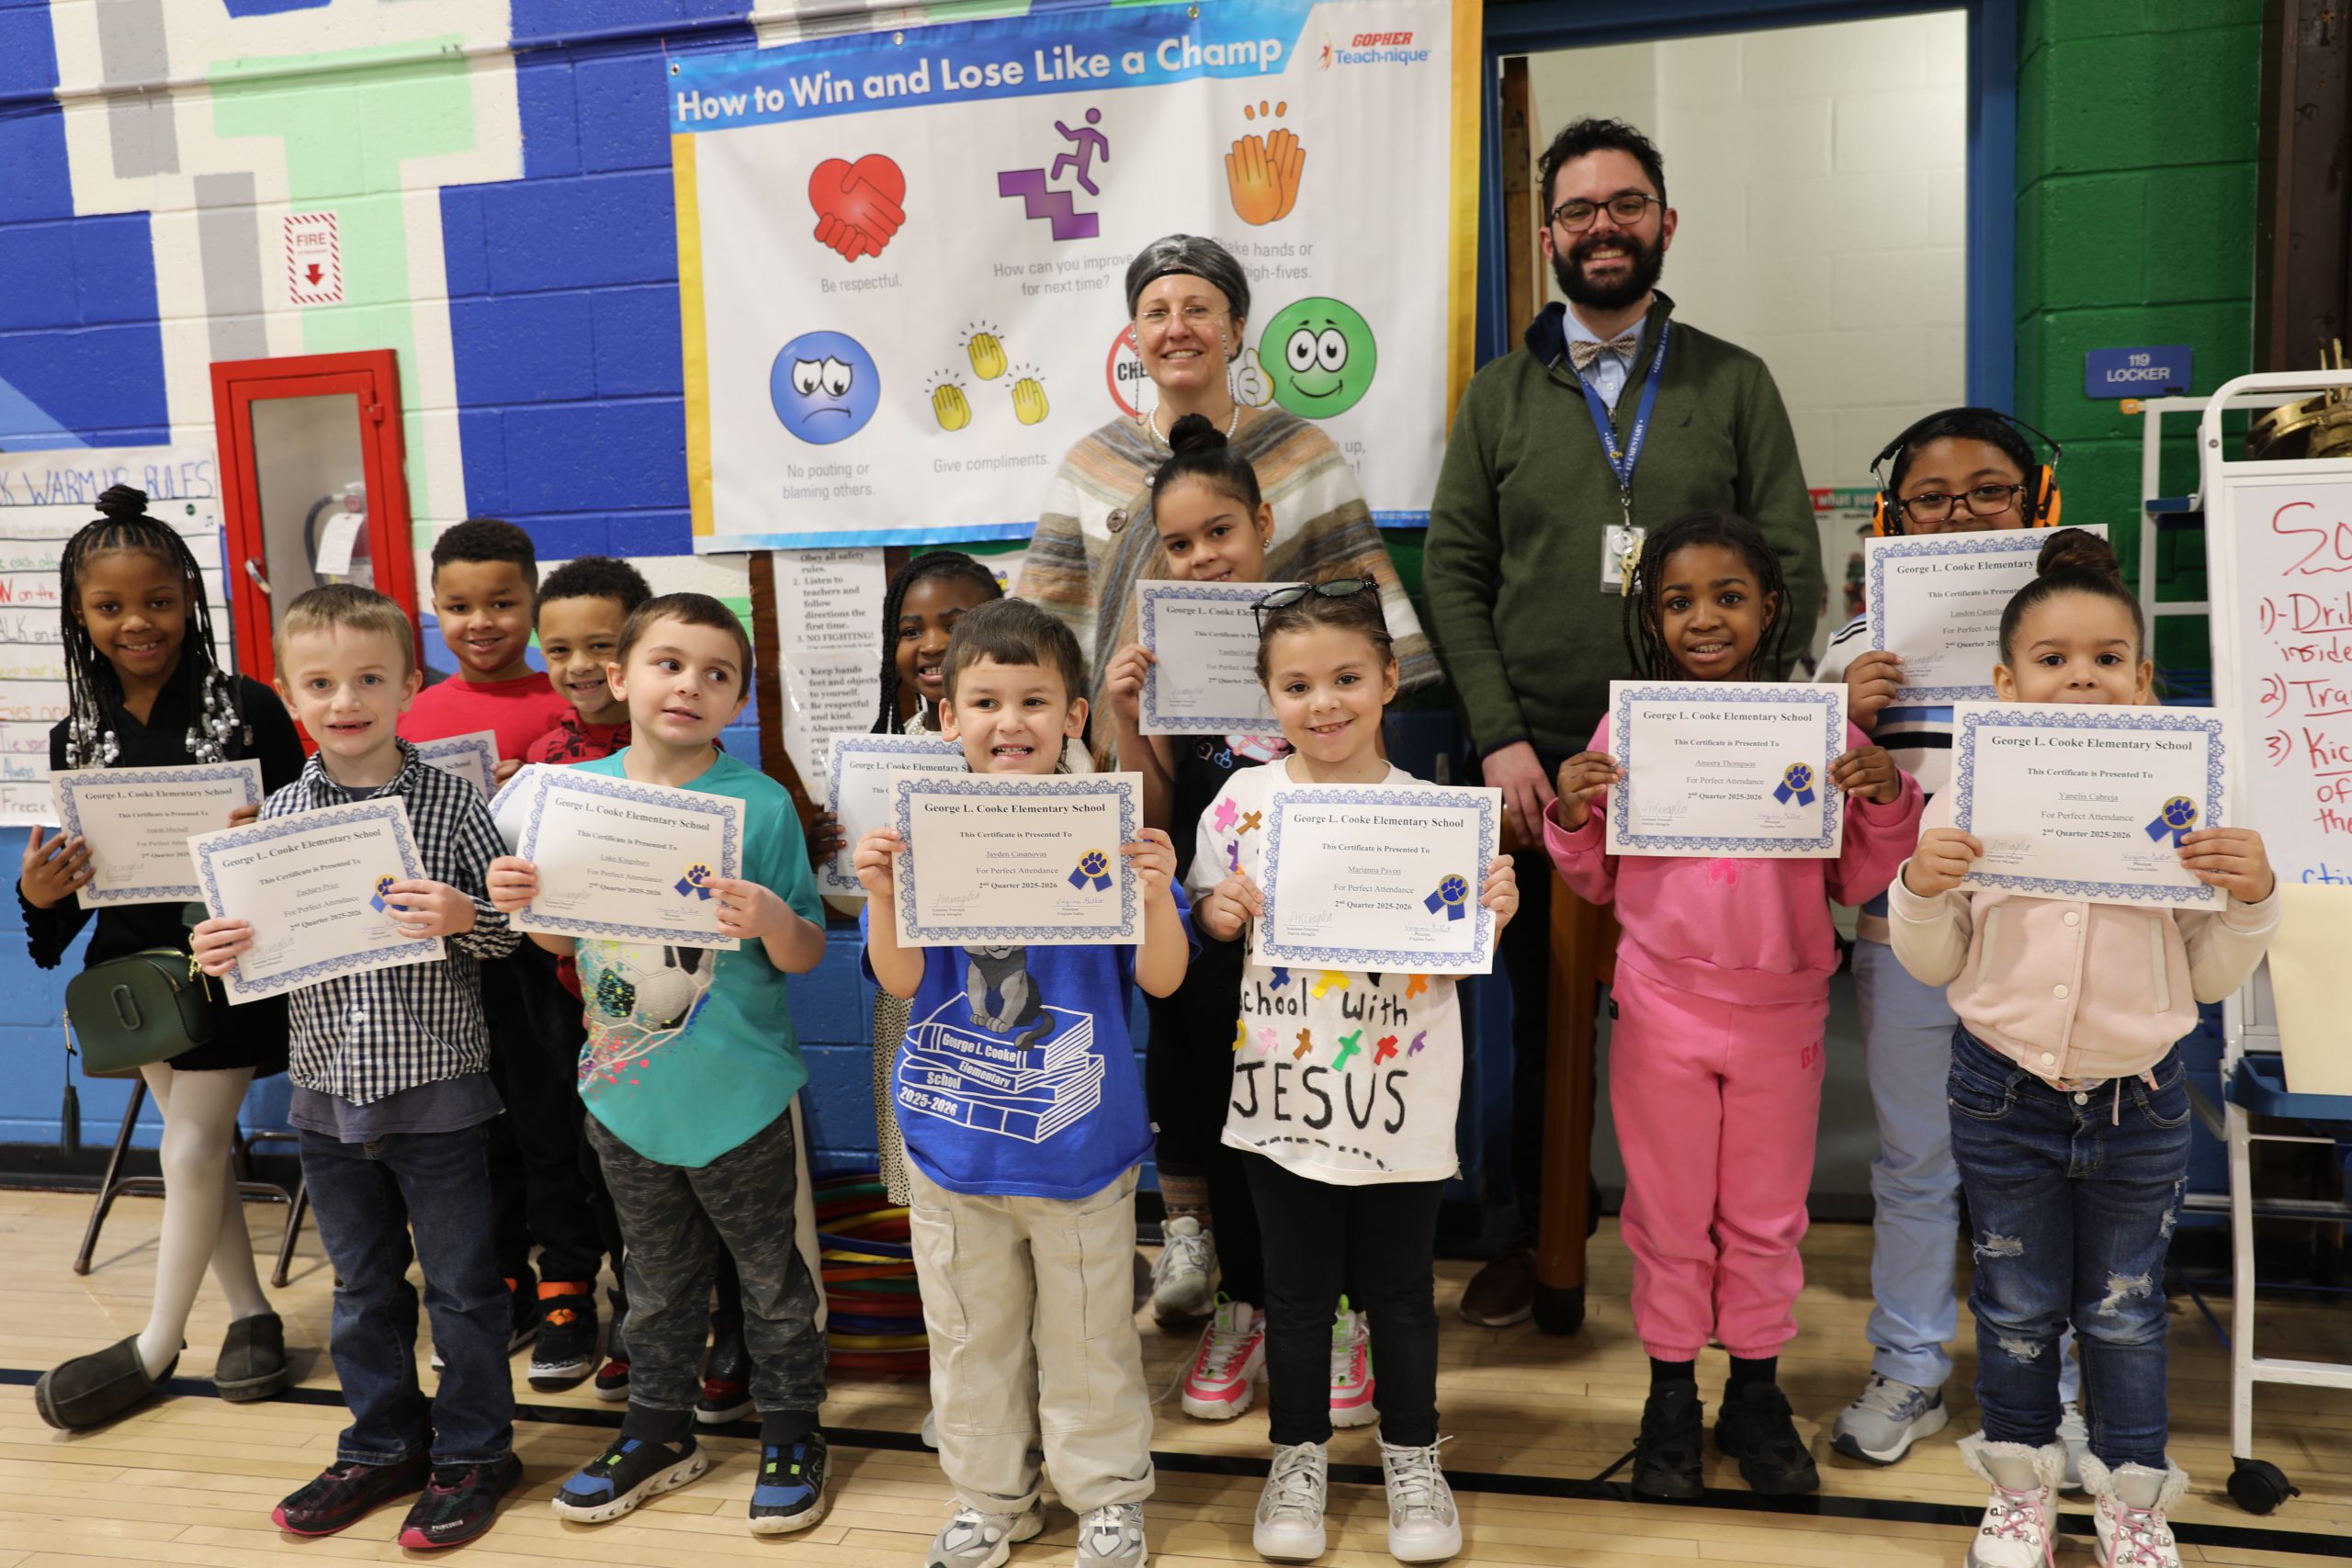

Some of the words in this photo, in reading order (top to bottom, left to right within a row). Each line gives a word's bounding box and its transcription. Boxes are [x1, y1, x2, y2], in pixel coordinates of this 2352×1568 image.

[1352, 32, 1413, 47] GOPHER
[676, 90, 747, 122] How
[754, 86, 786, 113] to
[789, 71, 854, 107] Win
[863, 58, 931, 99] and
[940, 58, 1024, 92] Lose
[1035, 45, 1111, 83] Like
[1121, 51, 1146, 74] a
[1156, 34, 1283, 73] Champ
[297, 233, 326, 246] FIRE
[1254, 243, 1295, 257] hands
[1299, 244, 1313, 255] or
[994, 264, 1024, 277] How
[1028, 262, 1053, 275] can
[1056, 260, 1080, 277] you
[1083, 254, 1133, 273] improve
[821, 278, 837, 293] Be
[840, 274, 902, 292] respectful.
[1022, 281, 1040, 296] for
[1044, 280, 1073, 295] next
[1076, 275, 1110, 292] time?
[2128, 353, 2151, 367] 119
[2107, 367, 2170, 382] LOCKER
[787, 464, 804, 479] No
[808, 461, 853, 481] pouting
[856, 463, 870, 476] or
[934, 458, 961, 474] Give
[966, 454, 1050, 472] compliments.
[23, 468, 96, 504] WARM
[144, 460, 213, 500] RULES
[783, 485, 830, 502] blaming
[833, 483, 875, 497] others.
[800, 553, 822, 562] Obey
[839, 552, 864, 560] safety
[1897, 565, 1930, 575] George
[1932, 563, 1942, 572] L.
[1945, 562, 1975, 572] Cooke
[1978, 558, 2034, 570] Elementary
[803, 588, 841, 596] teachers
[843, 586, 860, 594] and
[823, 633, 874, 641] FIGHTING!
[811, 668, 832, 676] Keep
[835, 666, 862, 674] hands
[847, 677, 877, 685] objects
[821, 689, 860, 698] yourself.
[825, 700, 869, 710] respectful
[810, 713, 828, 721] and
[831, 712, 853, 720] kind.
[1644, 711, 1677, 721] George
[1679, 711, 1689, 720] L.
[1692, 712, 1721, 720] Cooke
[1724, 712, 1778, 723] Elementary
[1781, 713, 1812, 722] School
[811, 725, 843, 733] Always
[1992, 735, 2031, 748] George
[2034, 737, 2046, 747] L.
[2049, 737, 2084, 748] Cooke
[2087, 738, 2152, 751] Elementary
[2155, 740, 2192, 750] School
[2, 787, 48, 813] Freeze
[924, 803, 960, 814] George
[964, 804, 974, 813] L.
[977, 805, 1009, 814] Cooke
[1012, 804, 1068, 815] Elementary
[1072, 804, 1105, 813] School
[1294, 814, 1326, 825] George
[1329, 815, 1338, 824] L.
[1341, 815, 1371, 825] Cooke
[1374, 816, 1429, 829] Elementary
[1431, 818, 1464, 828] School
[222, 854, 254, 869] George
[257, 852, 267, 861] L.
[269, 844, 300, 858] Cooke
[302, 834, 351, 851] Elementary
[354, 829, 381, 839] School
[986, 851, 1009, 859] Jayden
[1339, 844, 1374, 852] Certificate
[1384, 845, 1419, 853] Presented
[1348, 865, 1378, 874] Marianna
[1381, 867, 1401, 875] Pavon
[991, 882, 1019, 890] Quarter
[1348, 885, 1373, 893] Perfect
[1374, 886, 1414, 894] Attendance
[1335, 900, 1345, 908] 2nd
[1347, 901, 1374, 910] Quarter
[1377, 902, 1412, 910] 2025-2026
[942, 1032, 975, 1053] George
[976, 1042, 983, 1055] L.
[985, 1044, 1017, 1063] Cooke
[927, 1072, 962, 1089] School
[959, 1060, 1012, 1088] Elementary
[900, 1086, 957, 1116] 2025-2026
[1232, 1061, 1408, 1134] JESUS
